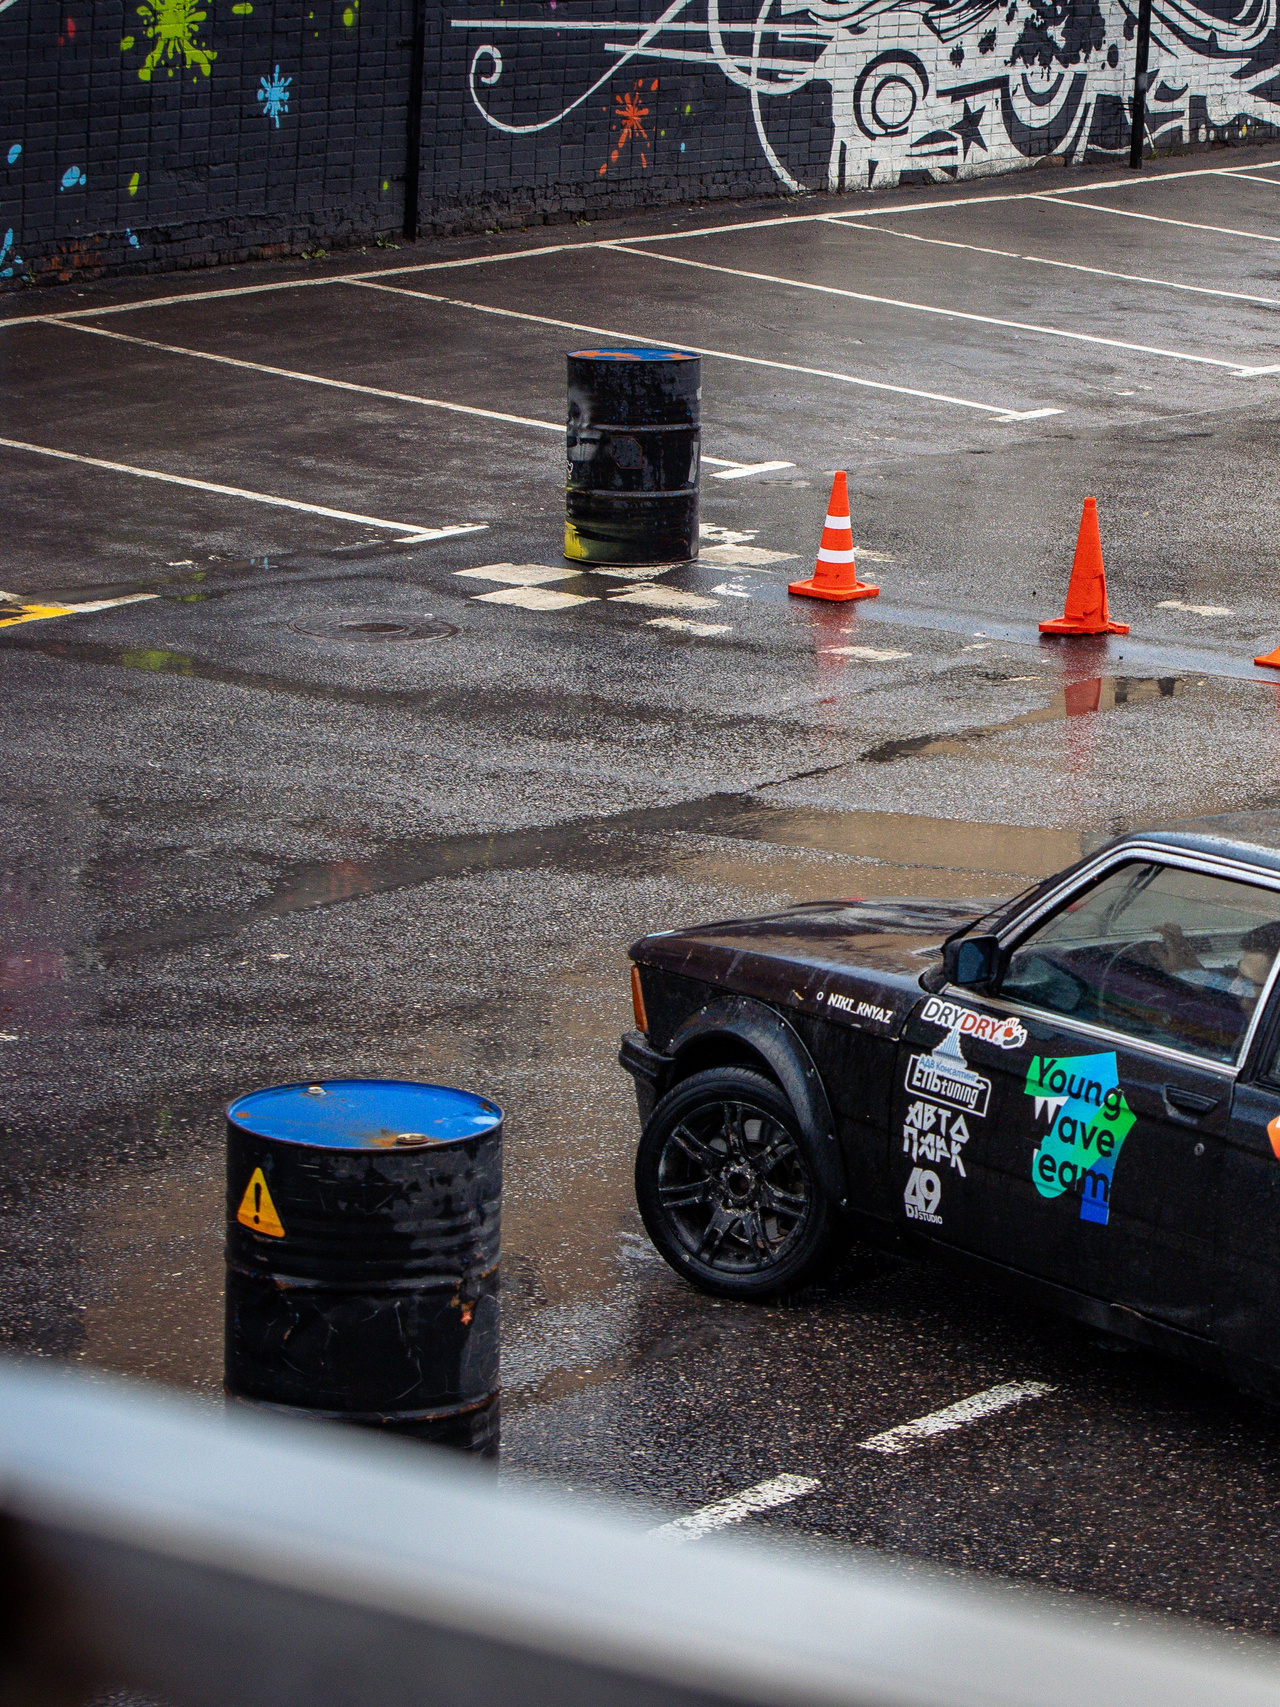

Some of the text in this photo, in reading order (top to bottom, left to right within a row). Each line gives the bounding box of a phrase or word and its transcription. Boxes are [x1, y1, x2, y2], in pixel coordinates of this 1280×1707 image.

[827, 992, 894, 1024] NIKI_KNYAZ
[922, 1000, 1004, 1040] DRYDRY
[919, 1056, 977, 1083] АДВ Консалтинг
[1038, 1056, 1123, 1122] Young
[918, 1211, 944, 1225] STUDIO
